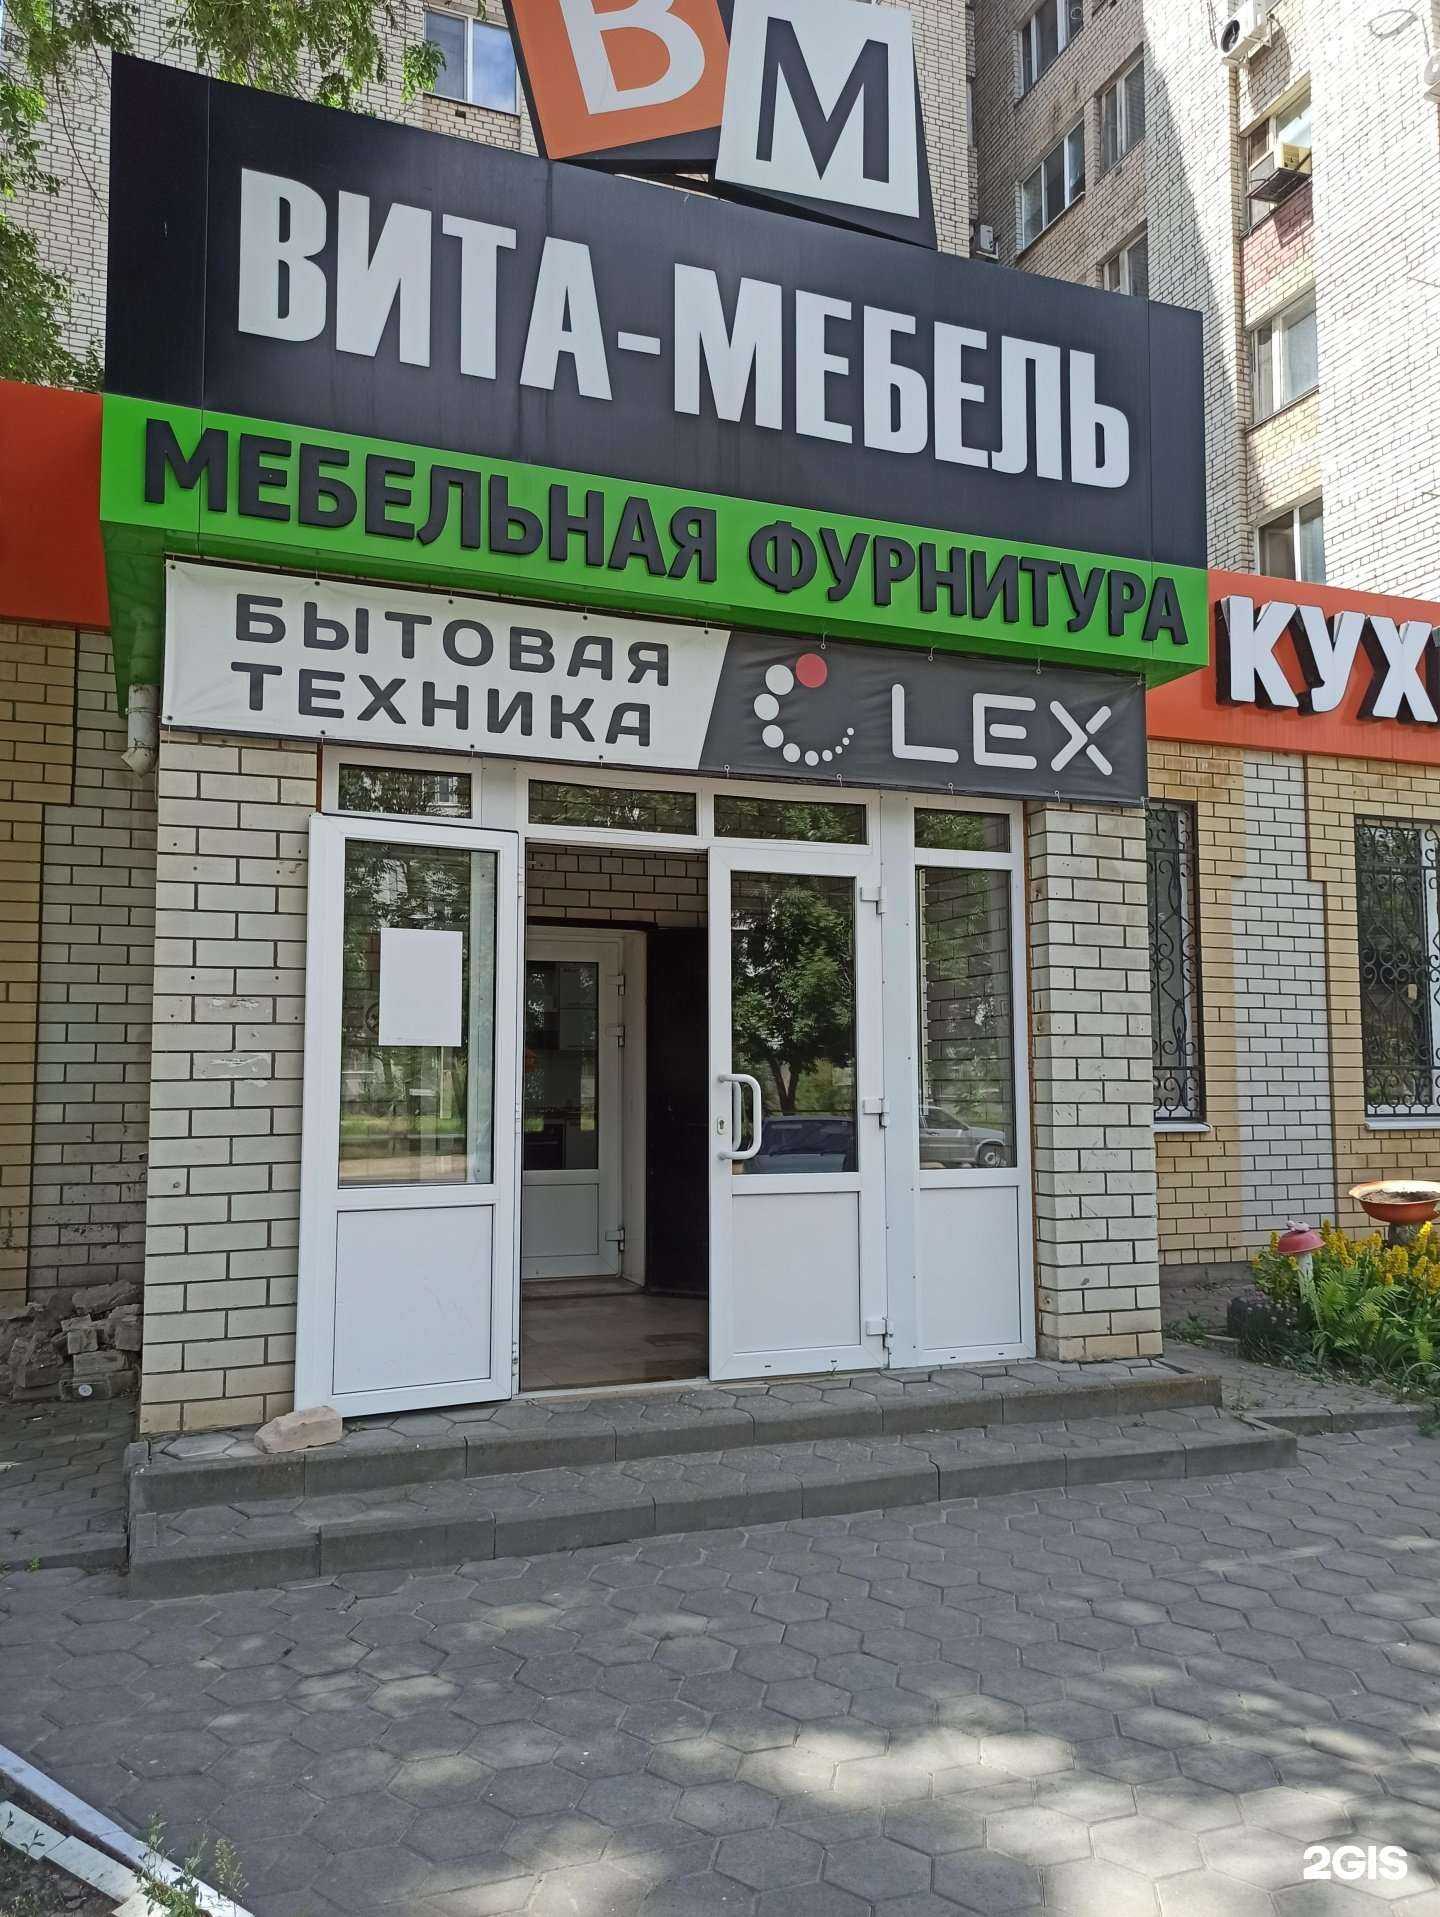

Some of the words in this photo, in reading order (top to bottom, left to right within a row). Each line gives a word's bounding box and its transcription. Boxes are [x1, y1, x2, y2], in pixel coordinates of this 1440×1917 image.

[237, 168, 1130, 489] ВИТА-МЕБЕЛЬ
[144, 418, 718, 583] МЕБЕЛЬНАЯ
[749, 520, 1189, 645] ФУРНИТУРА
[231, 661, 651, 748] ТЕХНИКА
[235, 593, 670, 687] БЫТОВАЯ
[1217, 595, 1440, 725] КУХ
